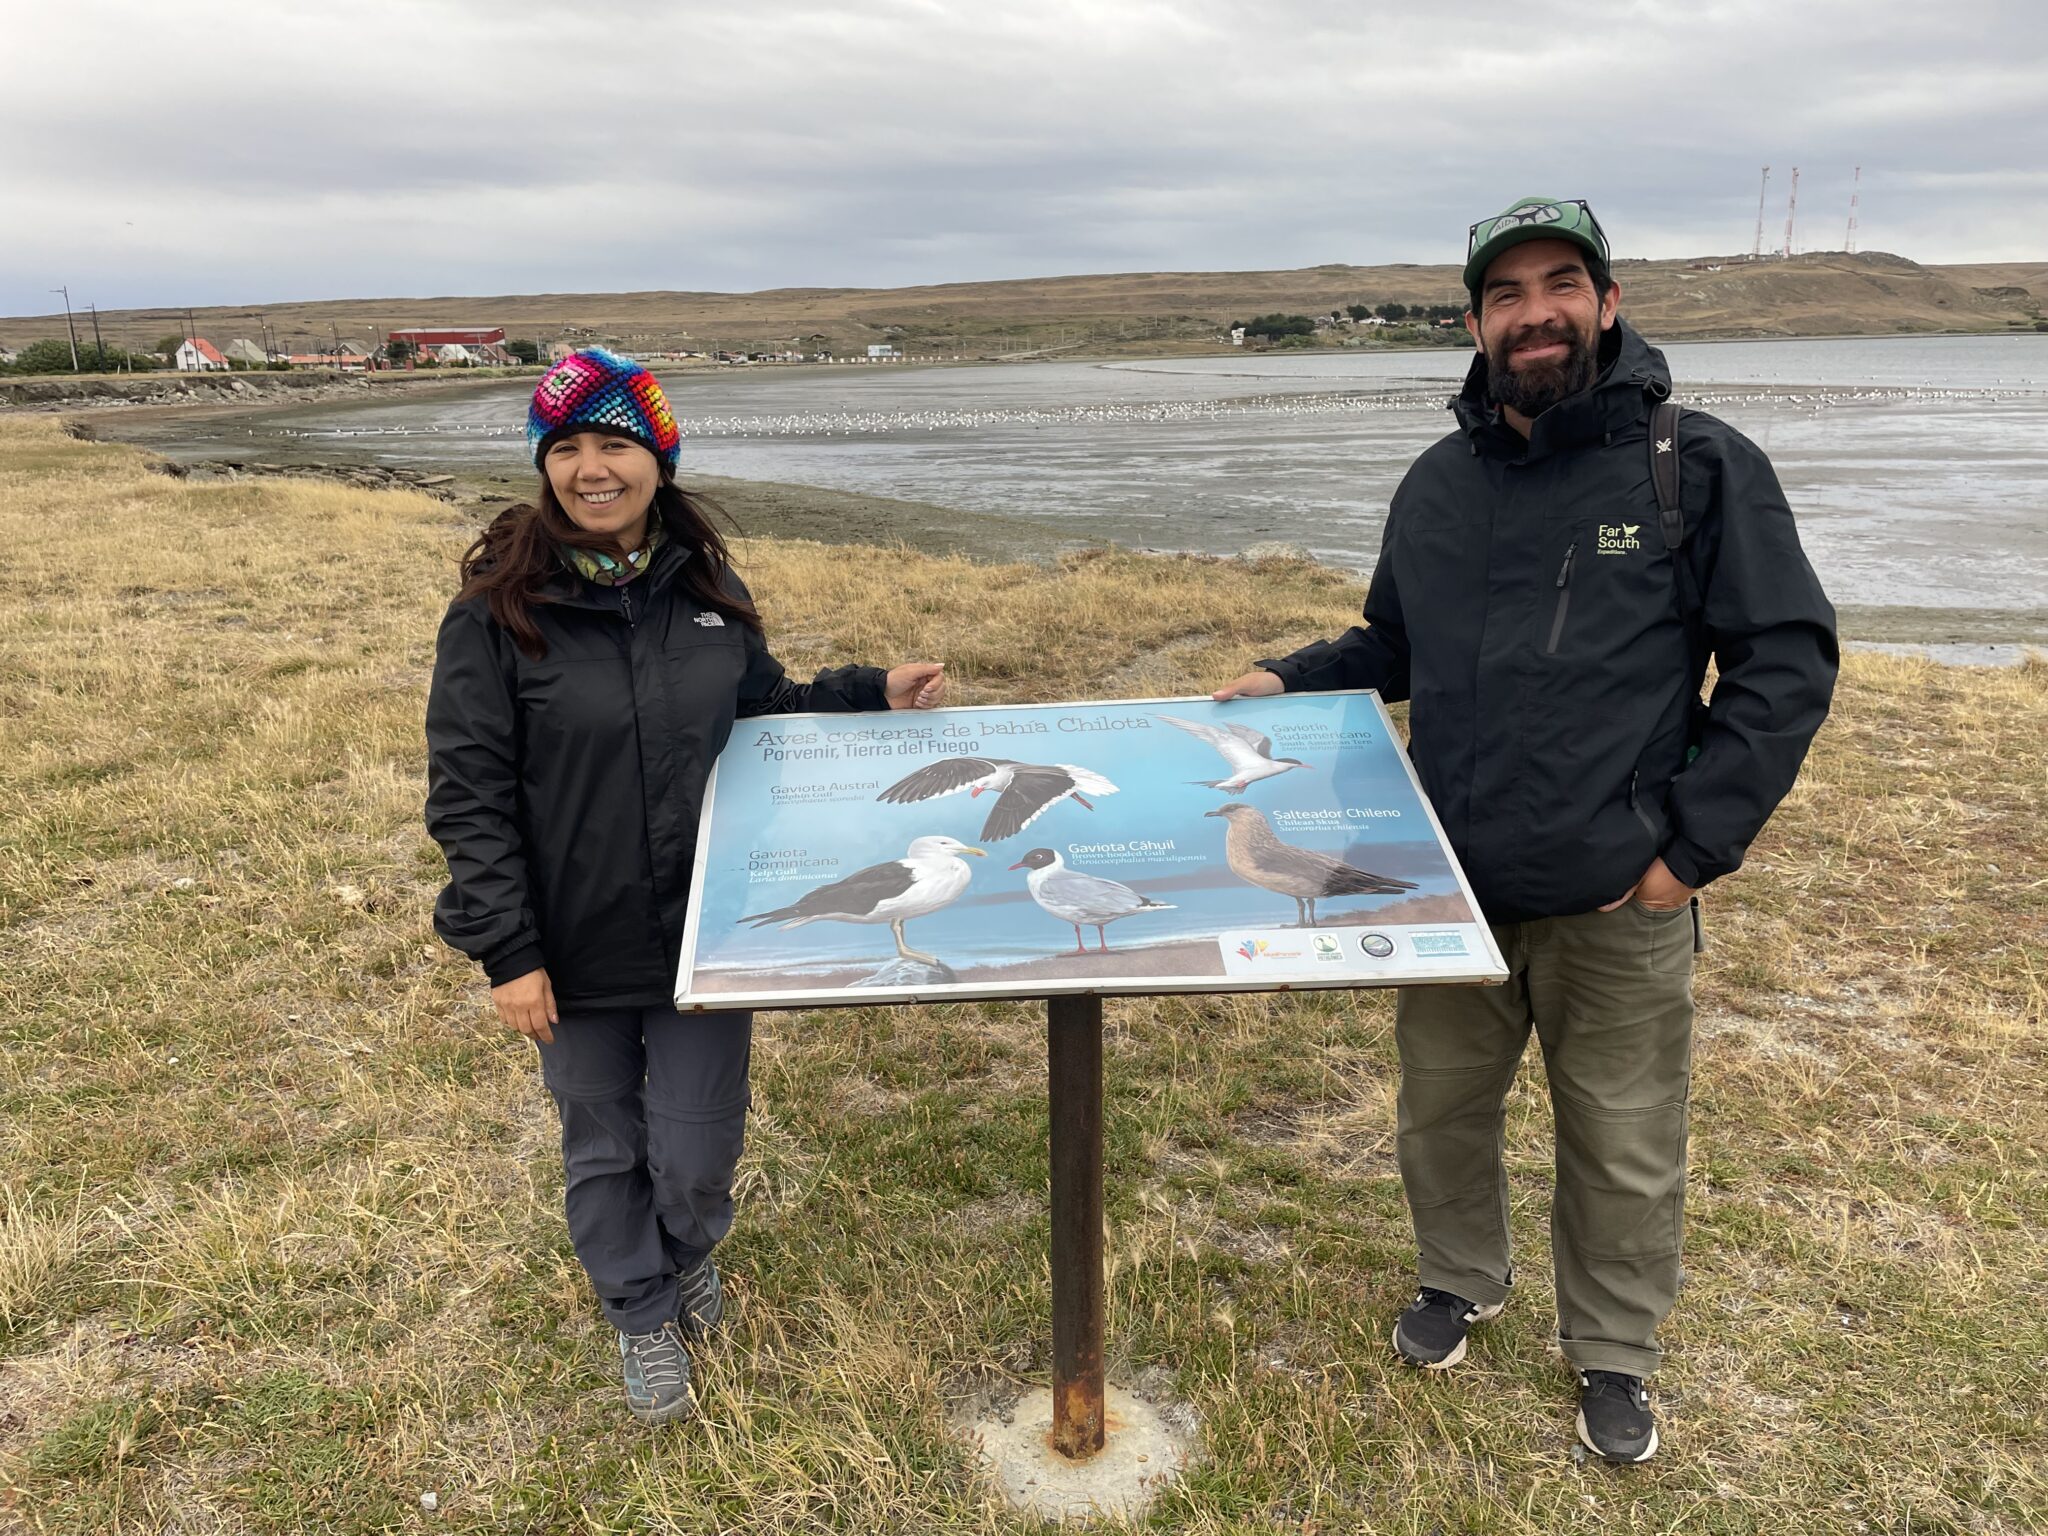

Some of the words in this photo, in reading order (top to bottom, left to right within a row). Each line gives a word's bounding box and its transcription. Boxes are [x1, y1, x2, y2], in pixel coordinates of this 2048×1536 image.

[1598, 525, 1621, 537] Far
[1598, 536, 1640, 549] South
[753, 731, 817, 746] Aves
[827, 727, 933, 742] costeras
[942, 723, 971, 738] de
[977, 721, 1048, 736] bahía
[1057, 715, 1152, 732] Chilota
[1273, 731, 1372, 741] Sudamericano
[763, 743, 839, 762] Porvenir,
[843, 742, 892, 758] Tierra
[897, 740, 923, 755] del
[928, 739, 979, 756] Fuego
[770, 785, 825, 795] Gaviota
[829, 780, 880, 791] Austral
[1272, 808, 1343, 820] Salteador
[1346, 808, 1401, 818] Chileno
[1068, 843, 1126, 854] Gaviota
[1128, 839, 1176, 851] Cáhuil
[749, 849, 808, 860] Gaviota
[749, 858, 840, 870] Dominicana
